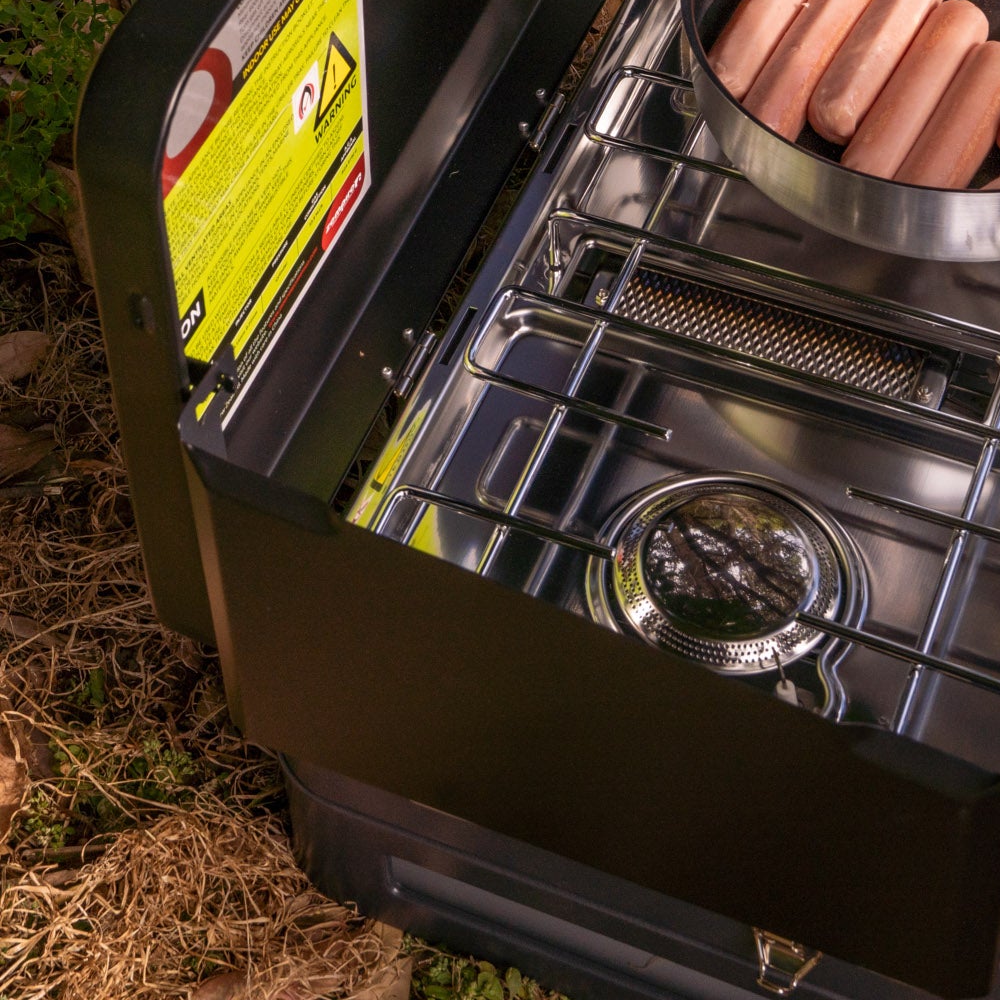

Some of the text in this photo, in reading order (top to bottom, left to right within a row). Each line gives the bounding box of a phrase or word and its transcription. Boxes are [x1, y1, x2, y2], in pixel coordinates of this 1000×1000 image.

[243, 38, 269, 80] INDOOR
[268, 19, 280, 44] USE
[315, 73, 357, 143] WARNING
[174, 264, 187, 288] ELL
